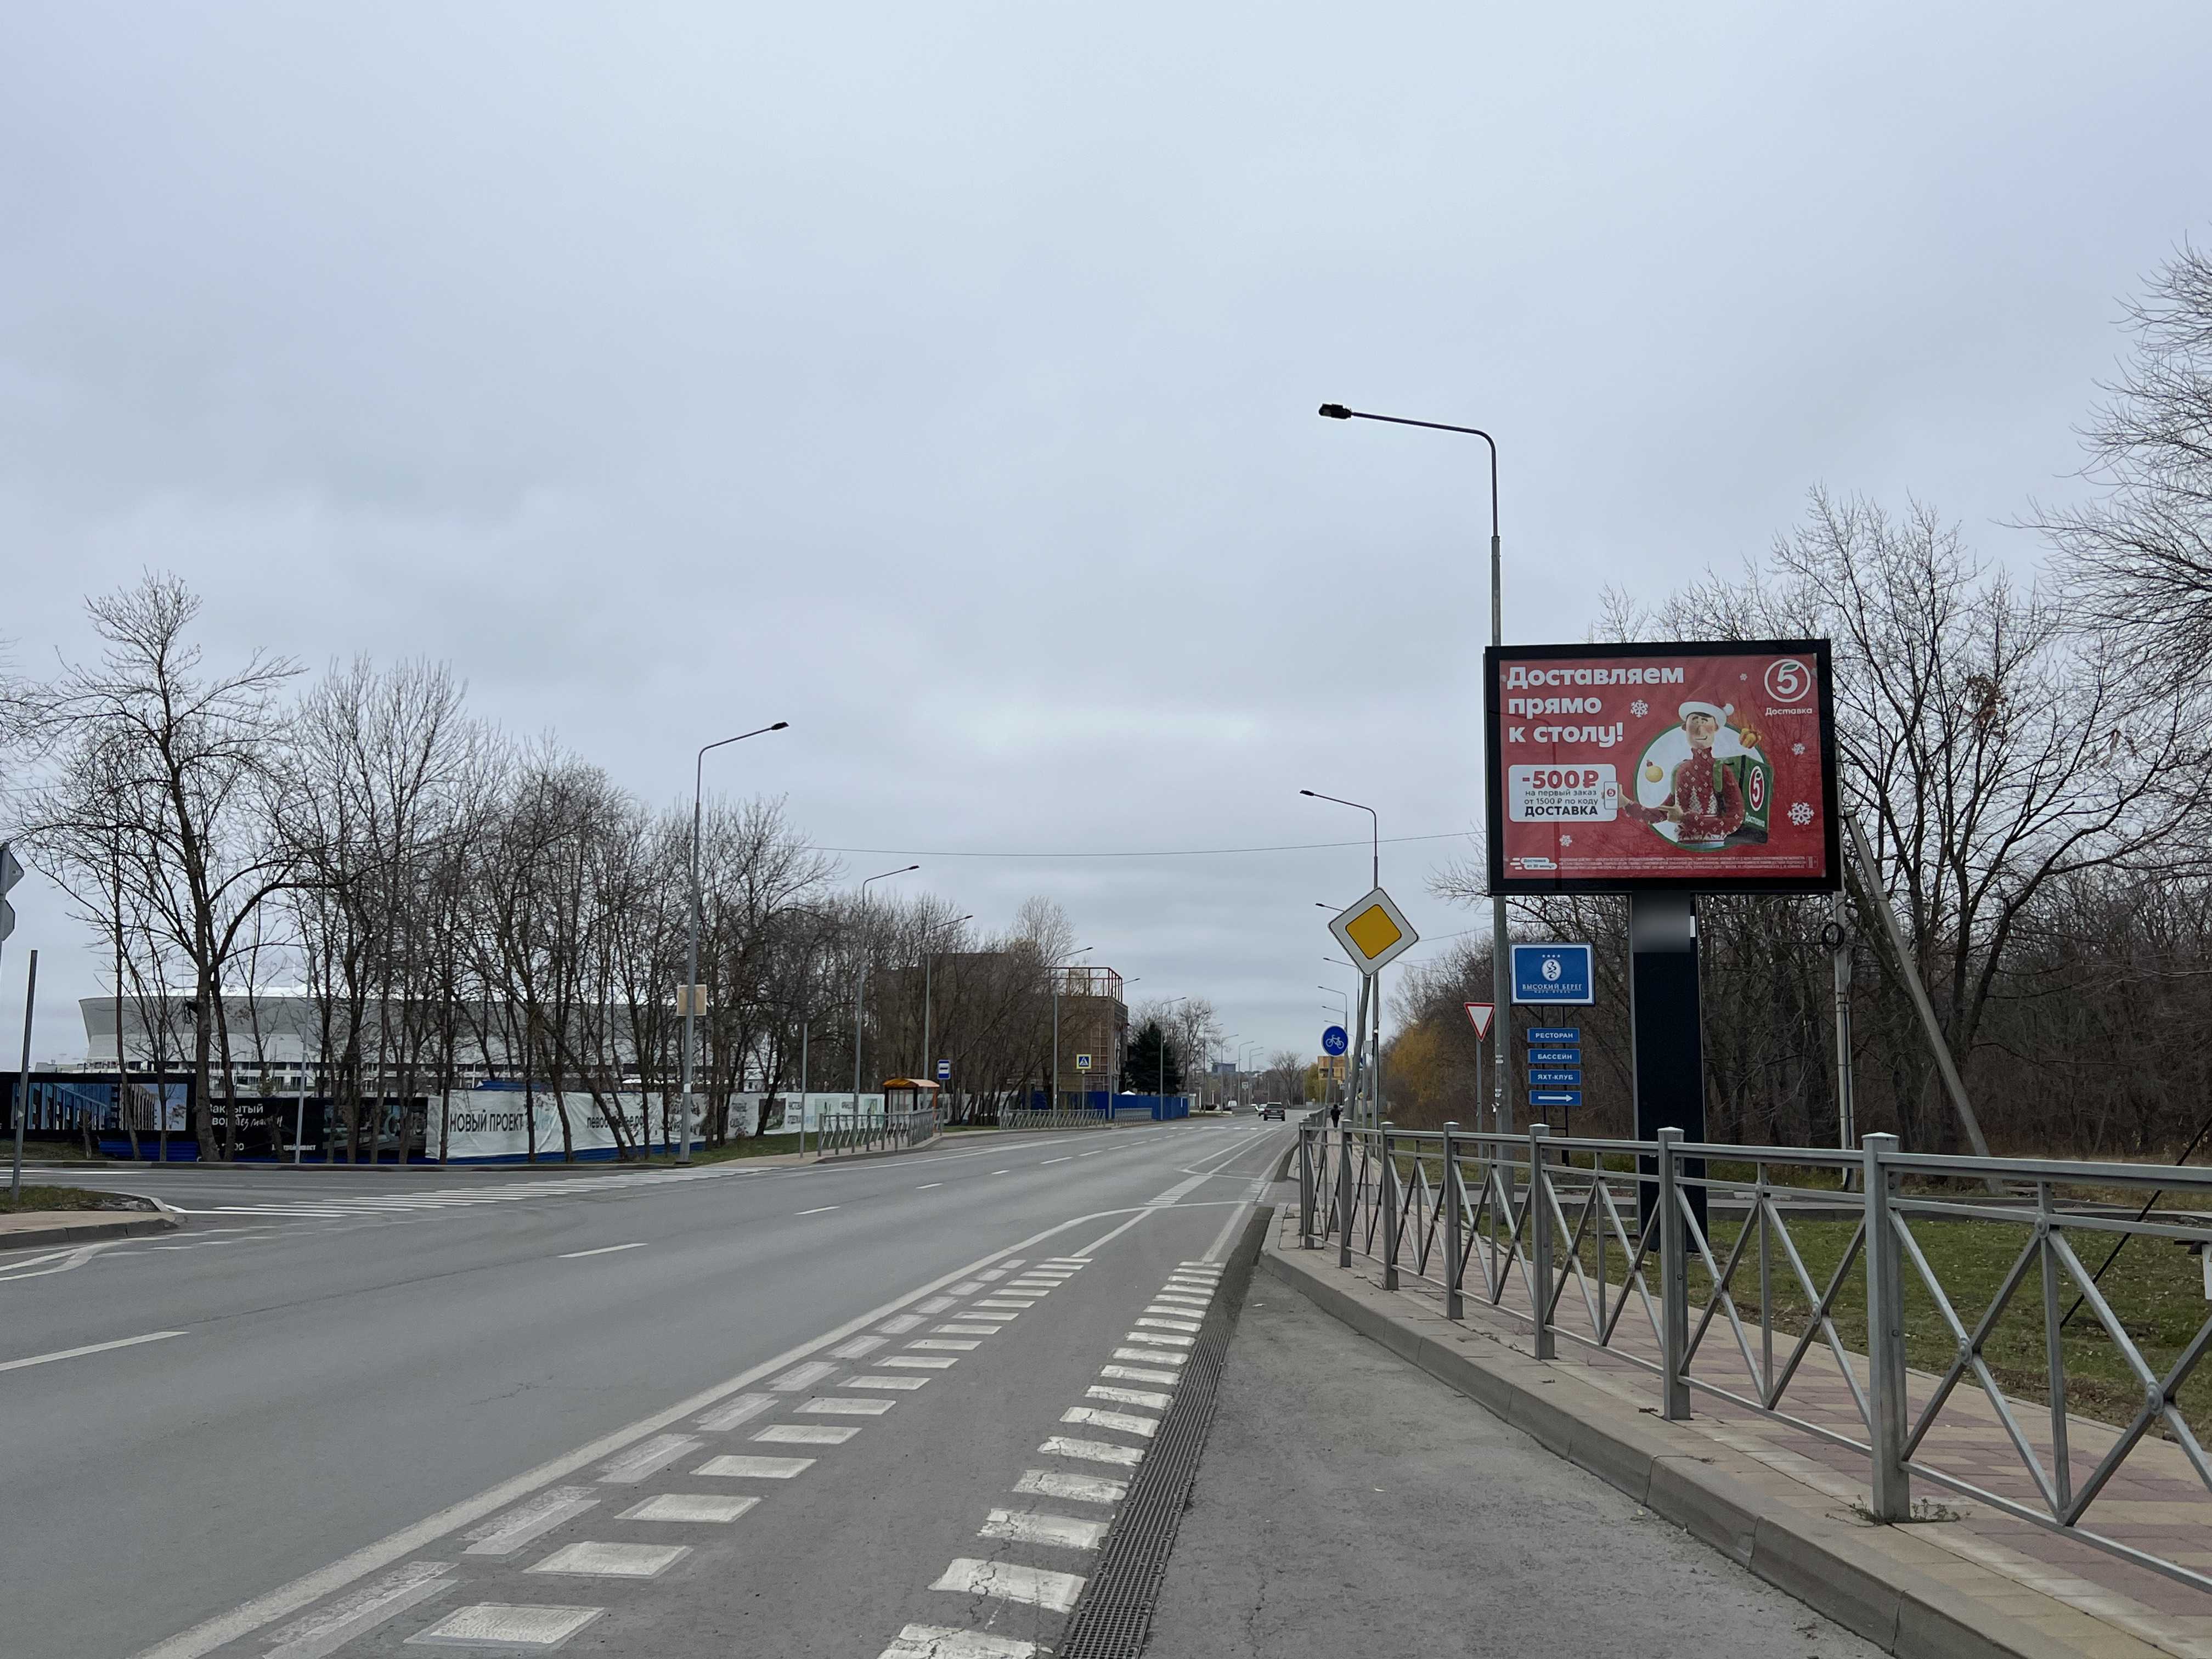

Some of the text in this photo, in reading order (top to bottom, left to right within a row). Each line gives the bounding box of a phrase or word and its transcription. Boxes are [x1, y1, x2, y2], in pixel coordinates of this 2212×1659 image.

[1507, 667, 1684, 690] Доставляем
[1776, 662, 1800, 694] 5
[1509, 697, 1602, 719] прямо
[1765, 708, 1813, 716] Доставка
[1509, 722, 1624, 748] к столу!
[1525, 806, 1598, 817] ДОСТАВКА
[449, 1109, 523, 1132] НОВЫЙ ПРОЕКТ
